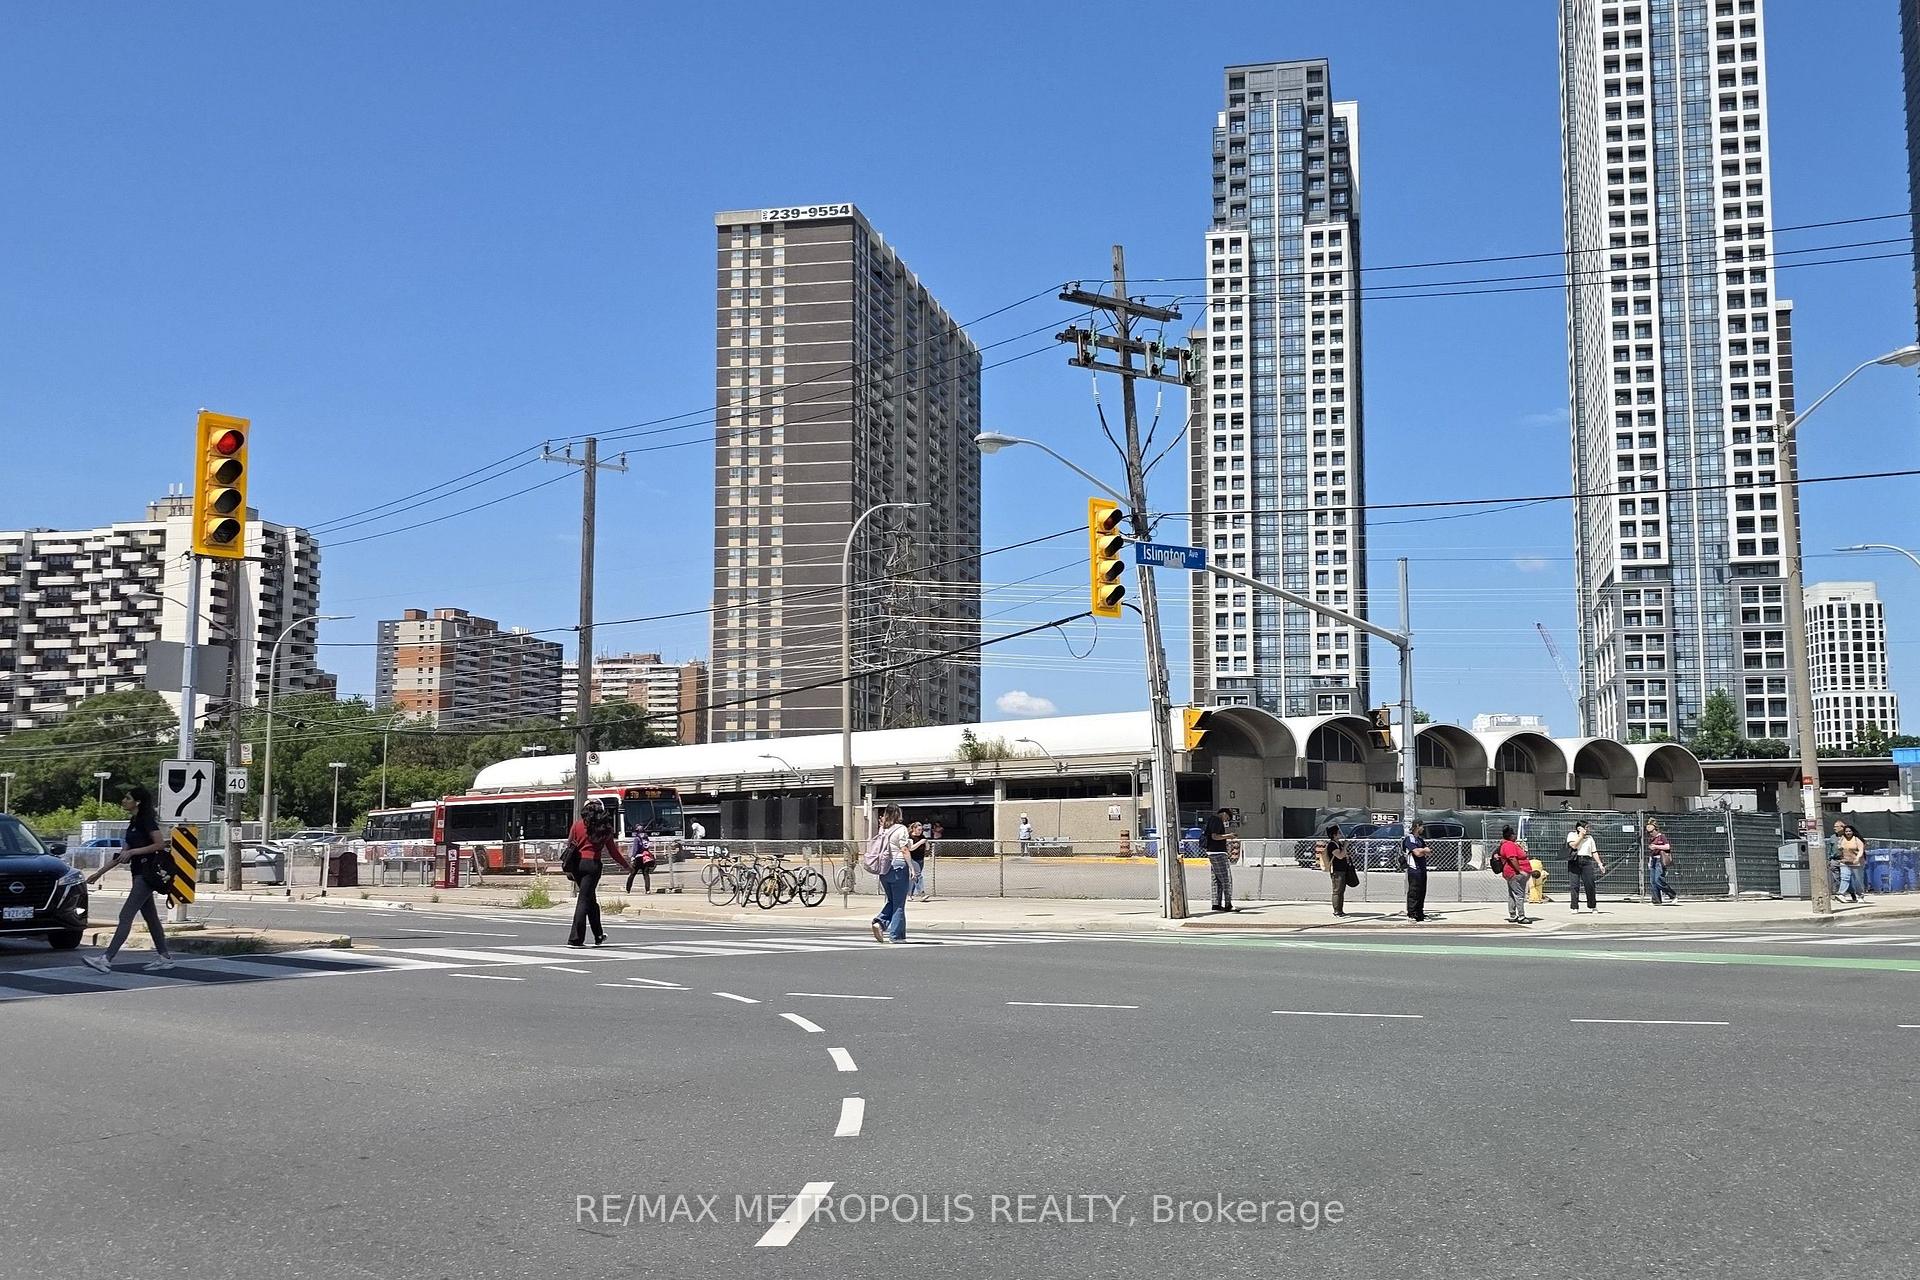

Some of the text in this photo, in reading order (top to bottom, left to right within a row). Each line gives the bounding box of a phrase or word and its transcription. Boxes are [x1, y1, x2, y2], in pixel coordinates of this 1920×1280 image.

[769, 205, 849, 220] 239-9554
[1143, 545, 1199, 564] Islington Ave
[229, 778, 245, 789] 40
